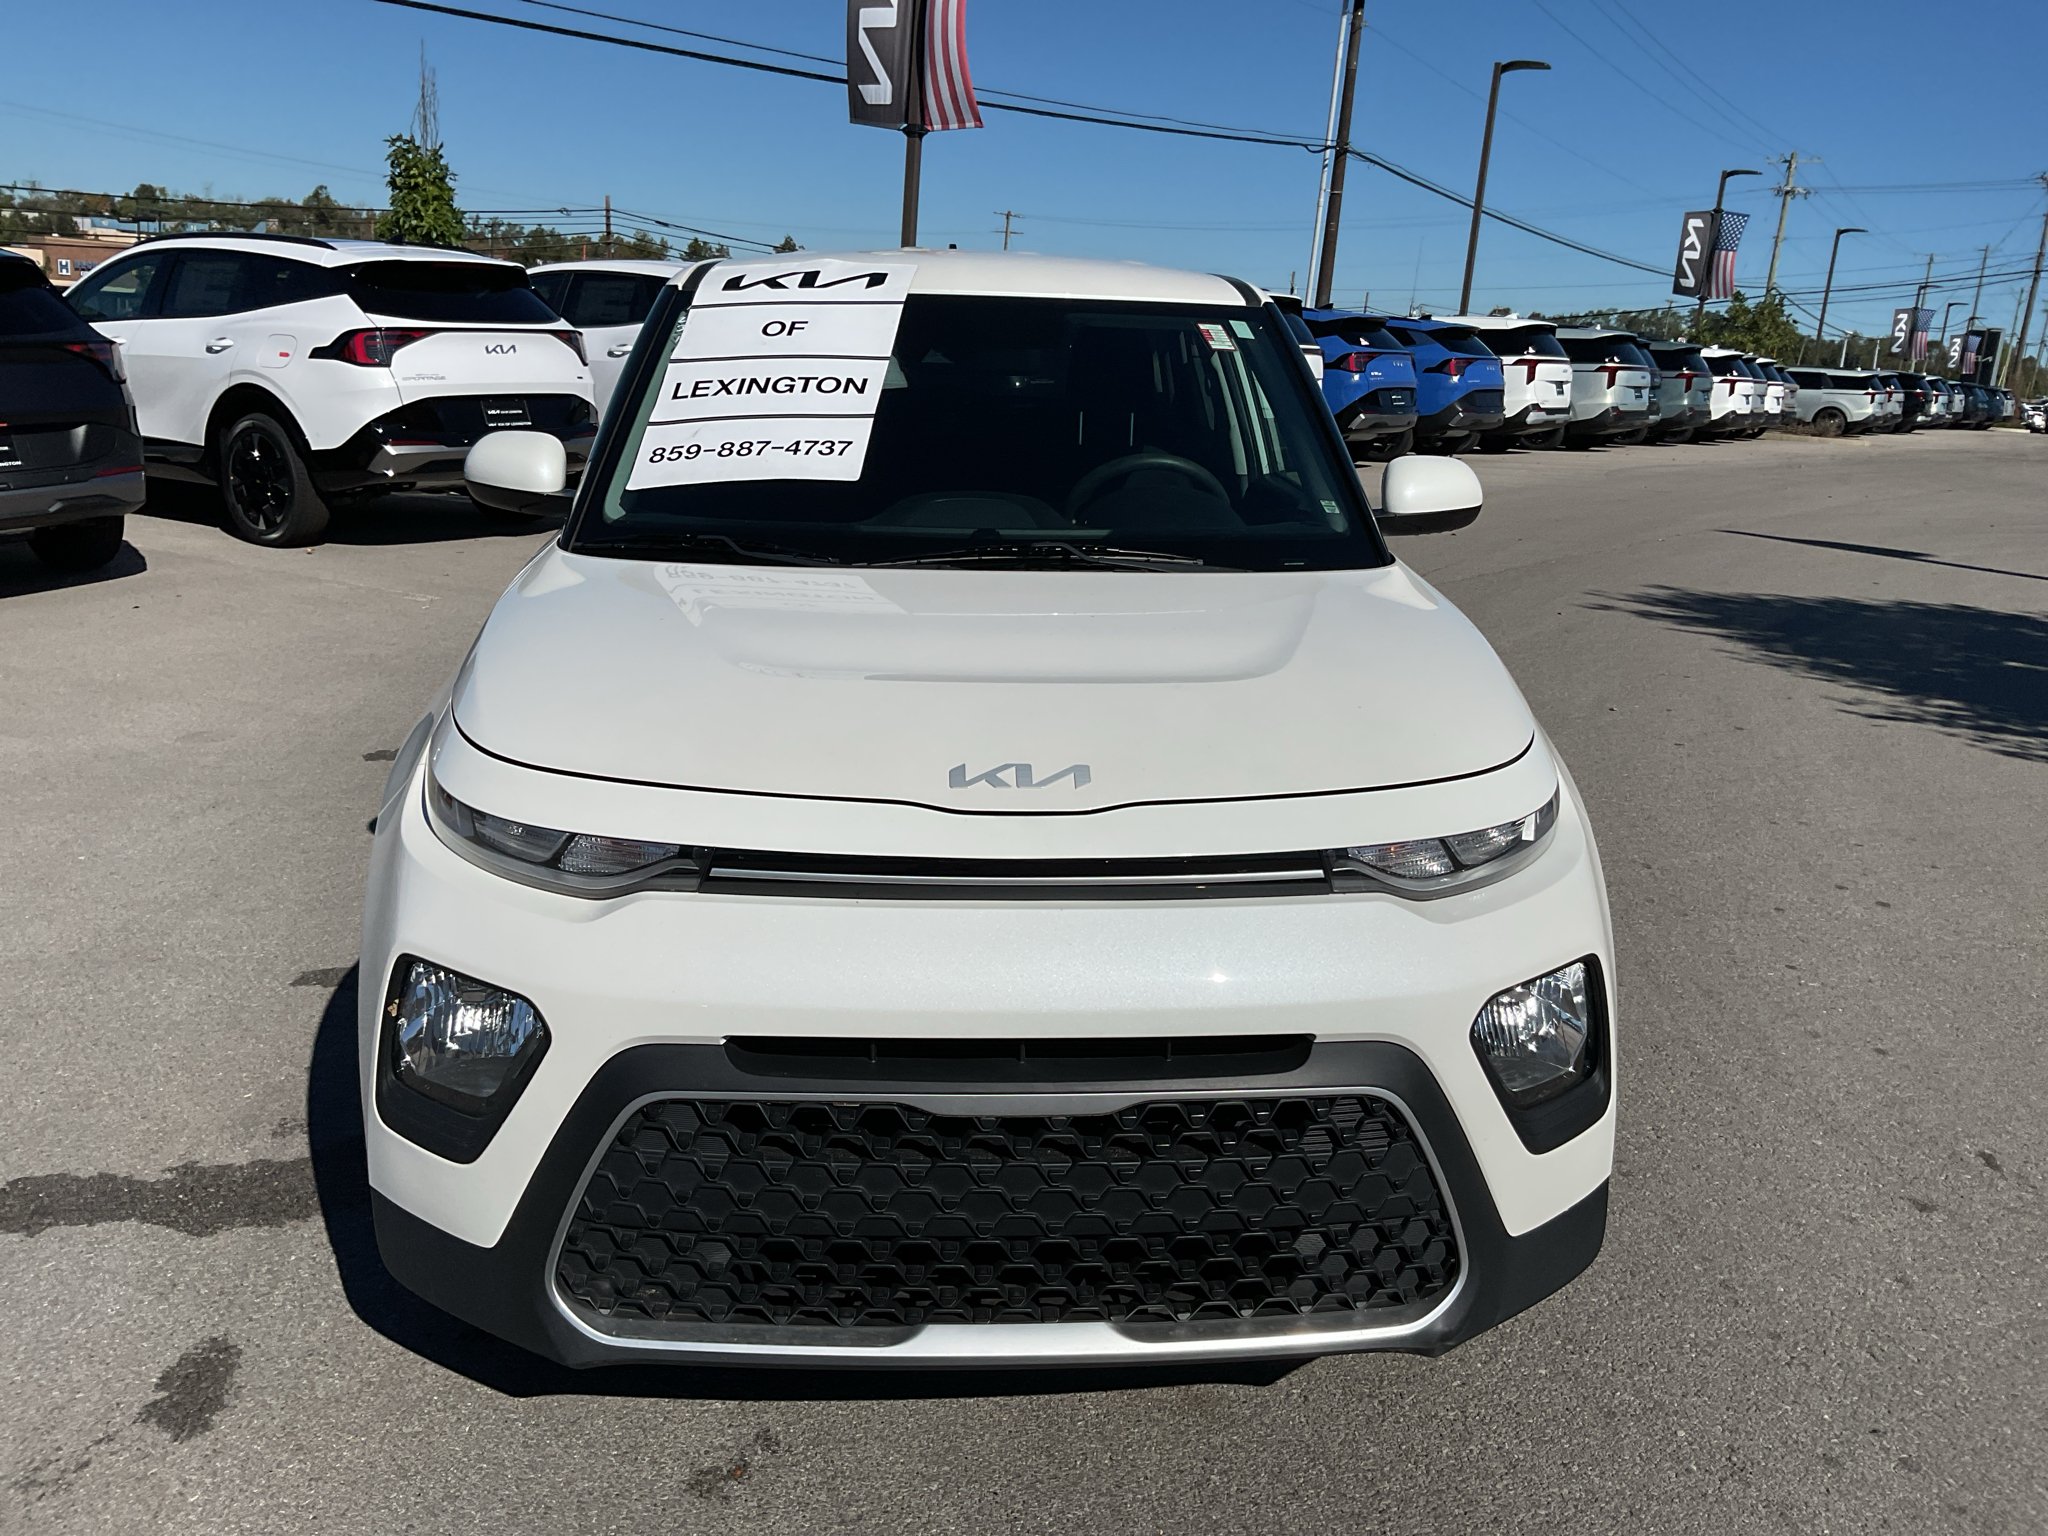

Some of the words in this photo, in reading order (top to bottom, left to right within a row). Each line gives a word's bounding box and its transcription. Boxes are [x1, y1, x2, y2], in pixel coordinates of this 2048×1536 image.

[1678, 217, 1705, 288] KIA
[721, 270, 889, 292] KIA
[760, 320, 808, 337] OF
[484, 344, 517, 355] KIA
[671, 376, 869, 401] LEXINGTON
[648, 439, 854, 464] 859-887-4737
[948, 763, 1092, 790] KIA
